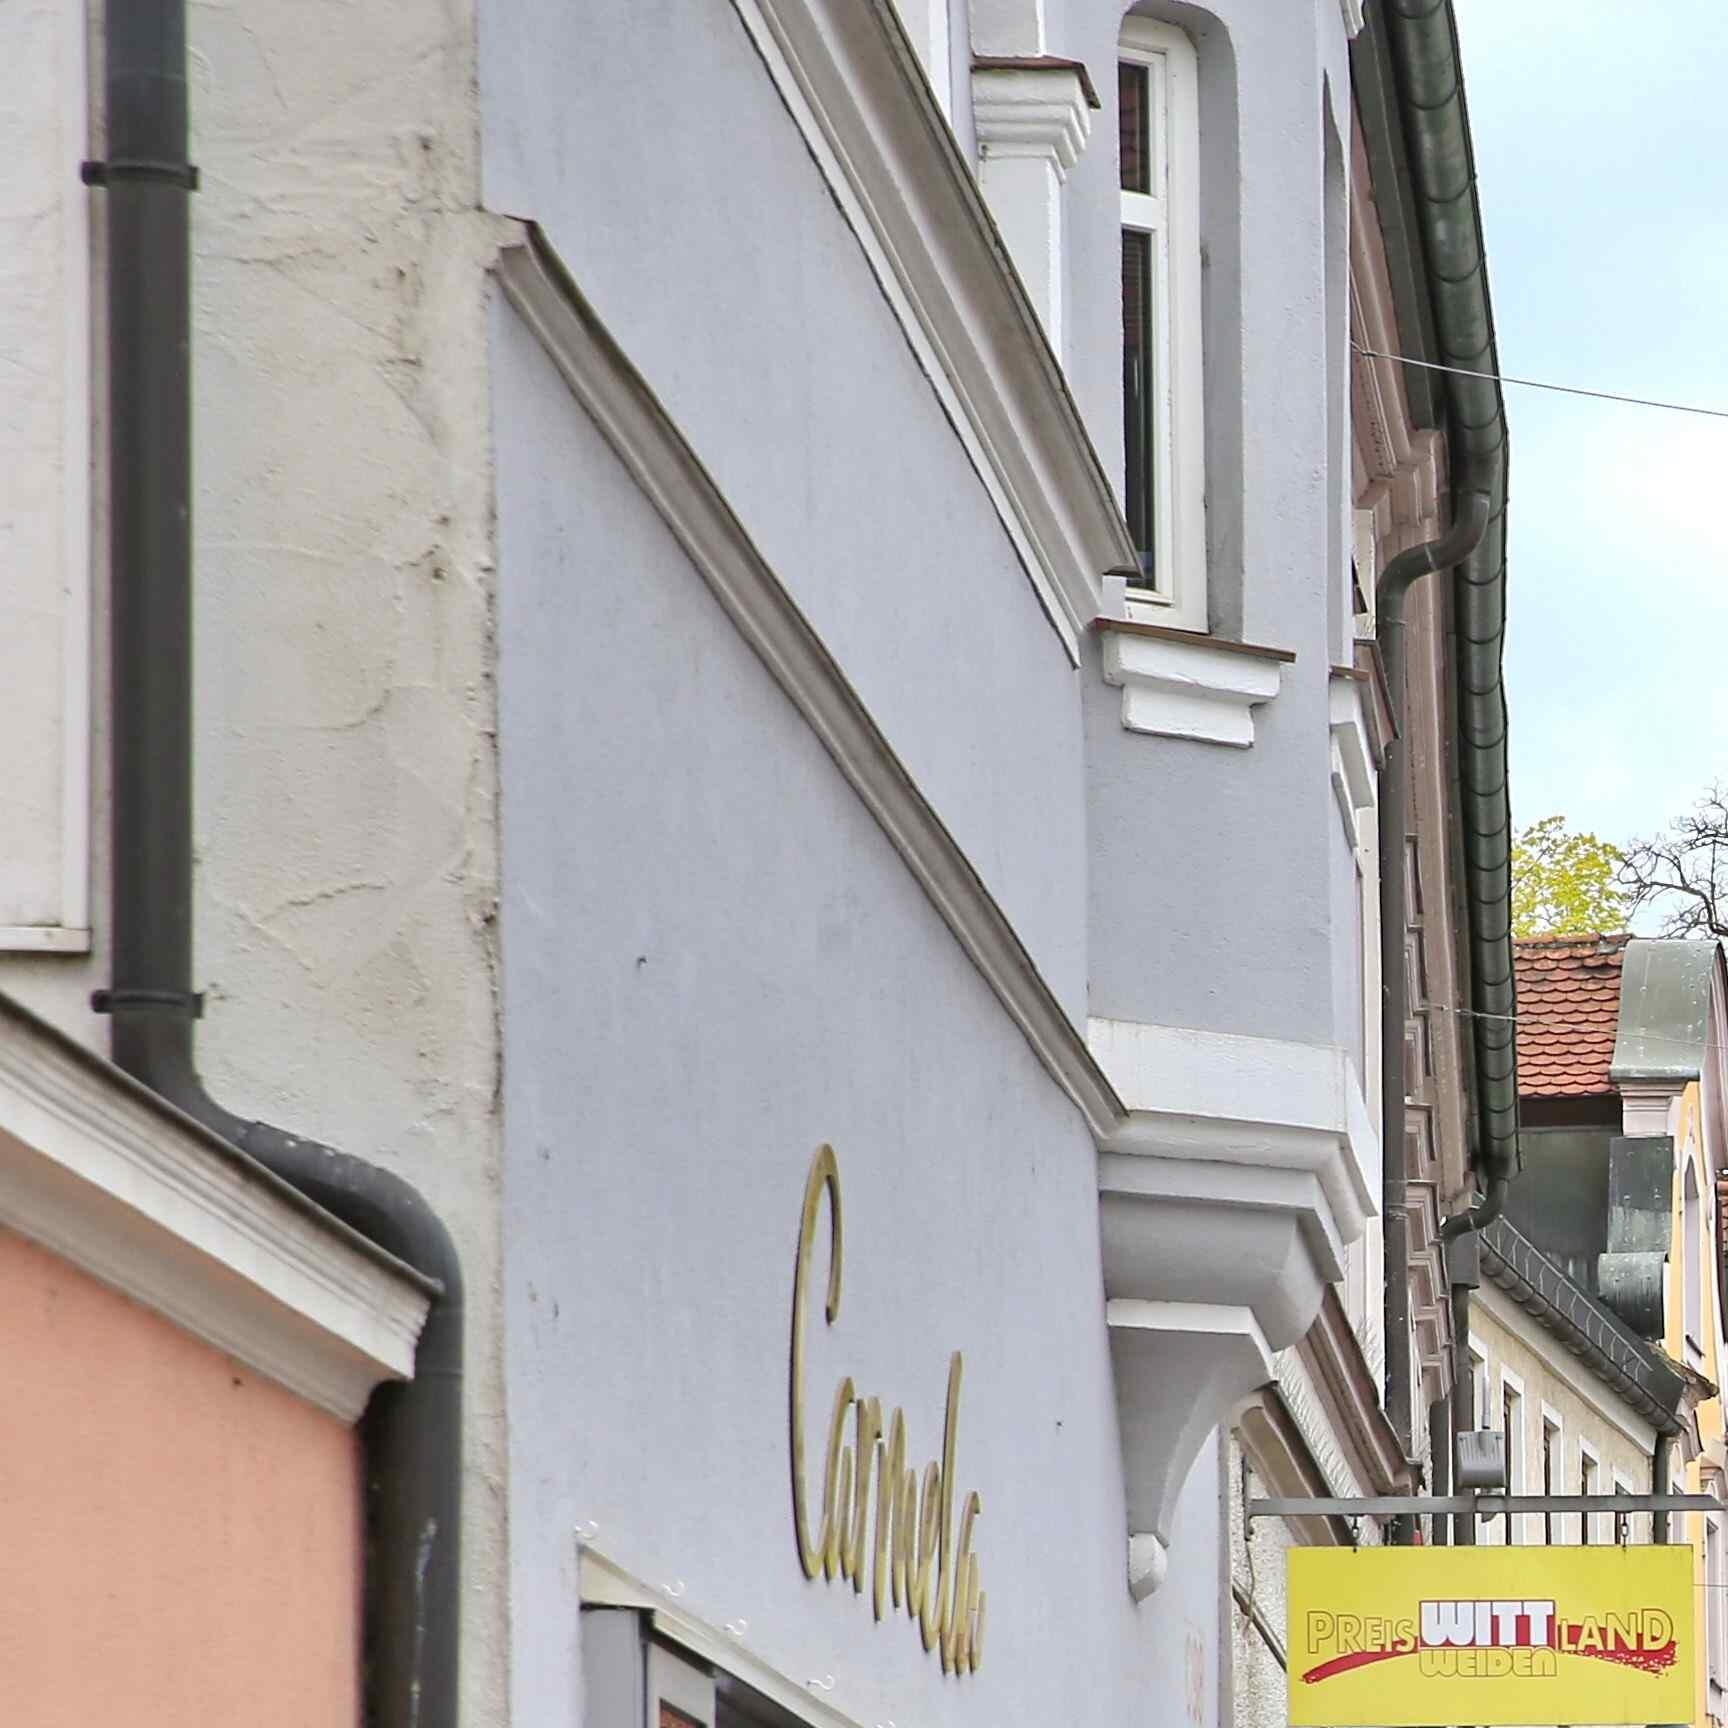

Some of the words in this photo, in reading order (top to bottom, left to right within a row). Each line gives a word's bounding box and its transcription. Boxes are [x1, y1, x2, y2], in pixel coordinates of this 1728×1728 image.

[1306, 1609, 1416, 1655] PREIS
[1419, 1600, 1556, 1648] WITT
[1560, 1608, 1674, 1652] LAND
